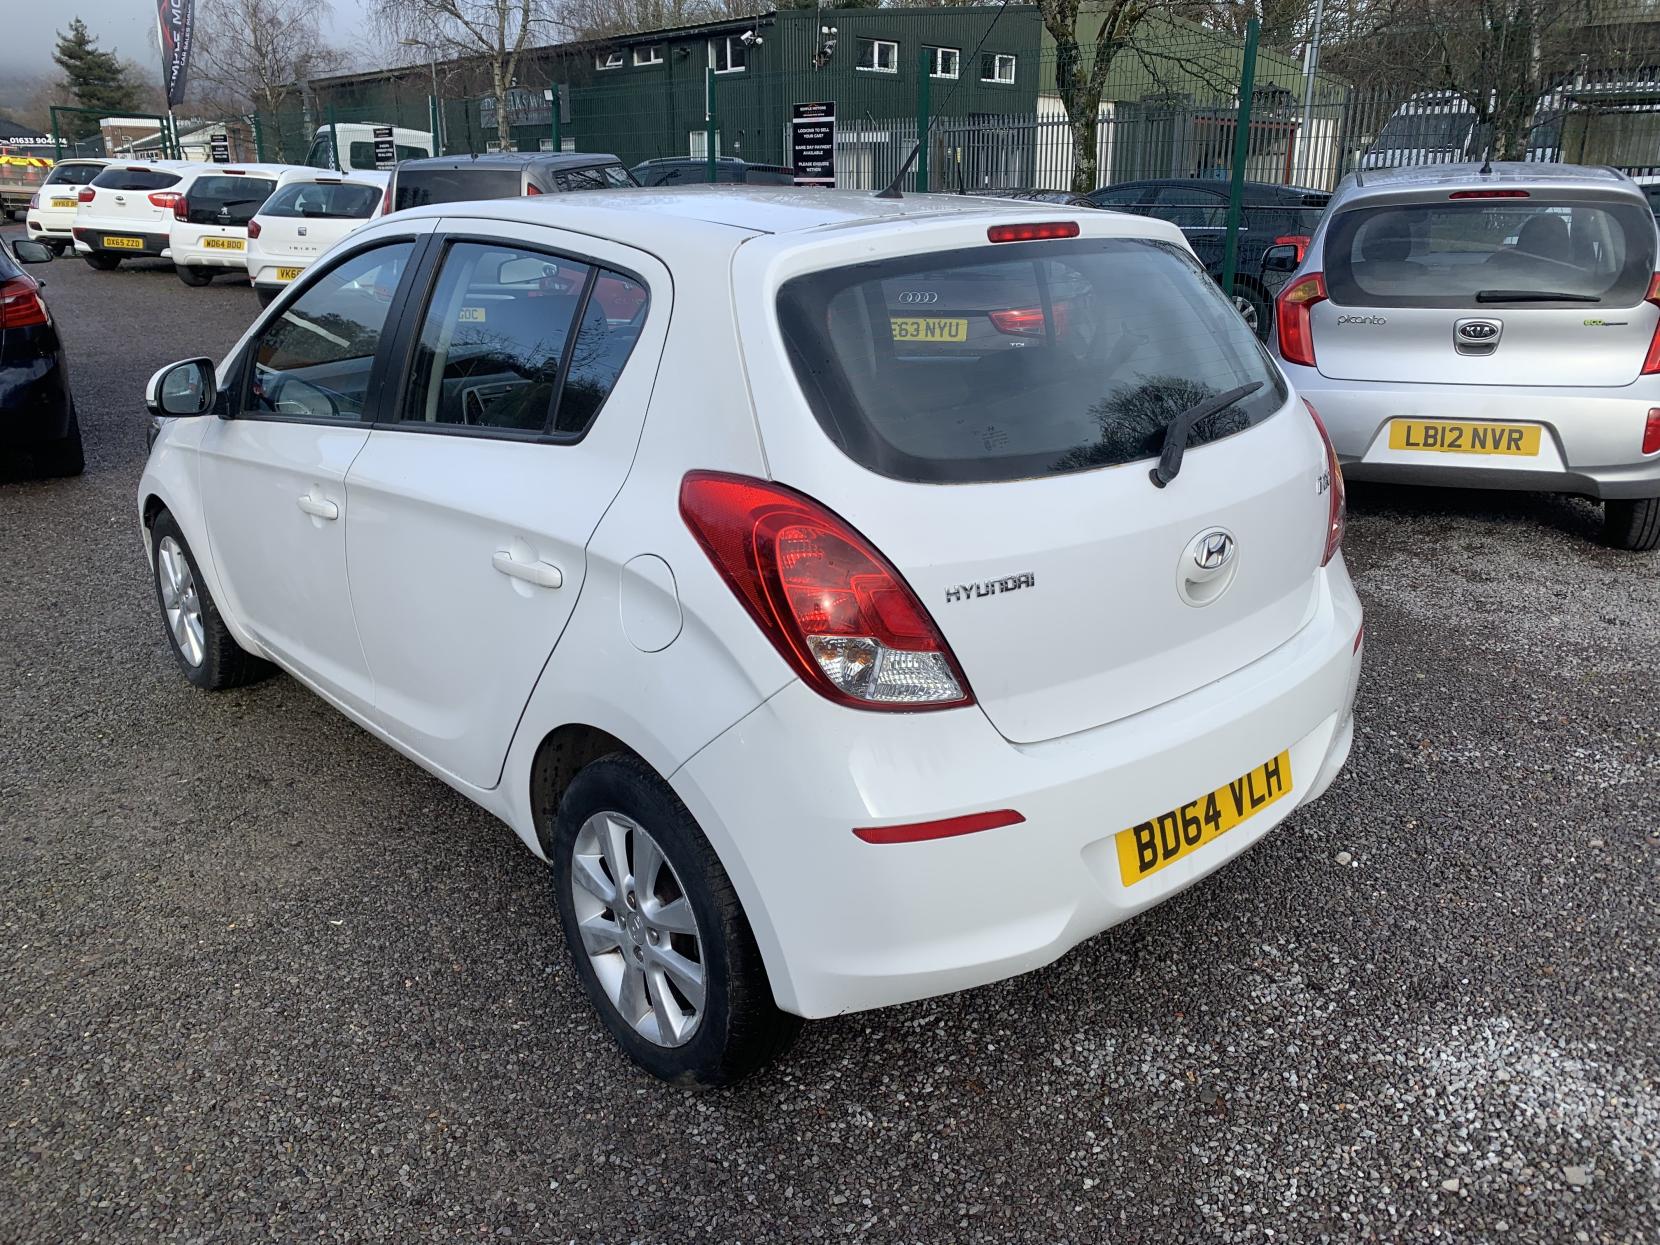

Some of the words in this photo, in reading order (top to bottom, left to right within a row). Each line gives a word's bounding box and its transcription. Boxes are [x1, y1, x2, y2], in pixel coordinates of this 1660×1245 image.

[183, 27, 191, 50] SALES
[106, 238, 125, 247] DX65
[206, 240, 226, 248] WD64
[1337, 314, 1387, 326] picanto
[925, 321, 959, 338] NYU
[1465, 326, 1491, 337] KIA
[1405, 425, 1464, 449] LB12
[1470, 427, 1524, 451] NVR
[944, 571, 1035, 603] HYUNDAI
[1132, 791, 1222, 874] BD64
[1228, 756, 1283, 818] VLH
